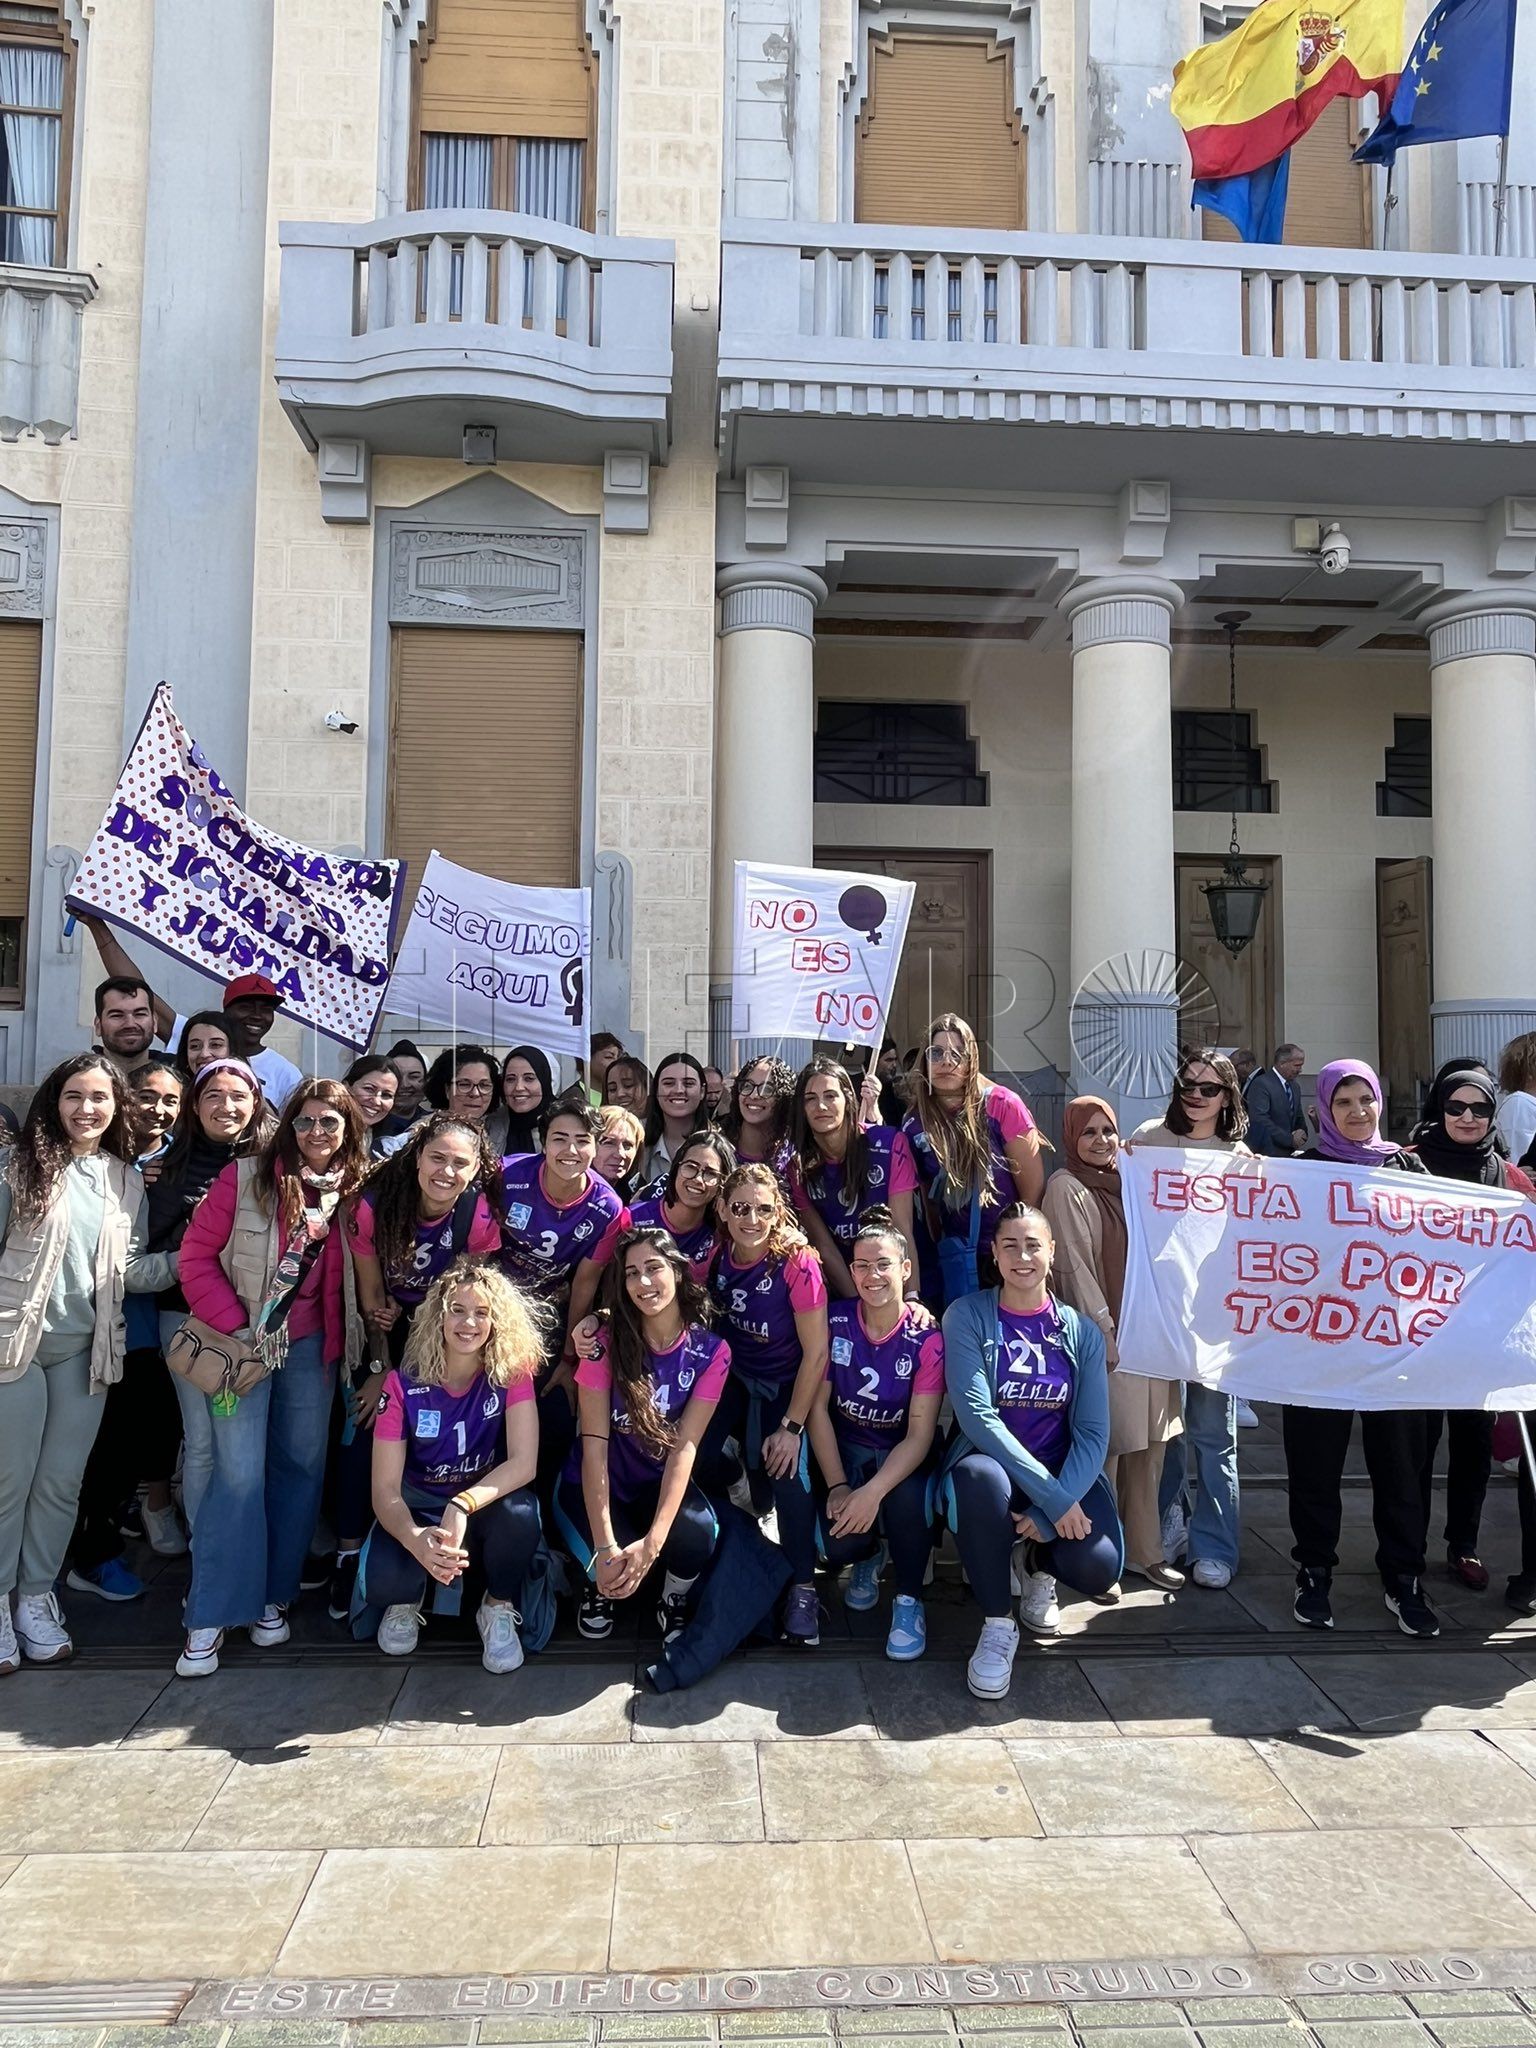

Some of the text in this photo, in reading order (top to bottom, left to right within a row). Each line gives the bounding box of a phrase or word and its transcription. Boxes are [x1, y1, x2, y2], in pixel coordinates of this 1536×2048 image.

[156, 775, 346, 935] SOCIEDD
[105, 802, 389, 986] DE IGUALDAD
[139, 870, 170, 912] Y
[750, 900, 817, 933] NO
[169, 905, 306, 1002] JUSTA
[792, 938, 851, 973] ES
[447, 962, 549, 1007] AQUI
[816, 991, 879, 1031] NO
[1152, 1168, 1536, 1252] ESTA LUCHA
[412, 1242, 434, 1270] 6
[532, 1230, 559, 1258] 3
[1236, 1240, 1466, 1303] ES POR
[731, 1288, 748, 1312] 8
[1008, 1339, 1046, 1375] 21
[857, 1366, 880, 1401] 2
[837, 1395, 905, 1423] MELILLA
[452, 1420, 467, 1456] 1
[221, 1956, 1485, 2014] ESTE EDIFICIO CONSTRUIDO COMO
